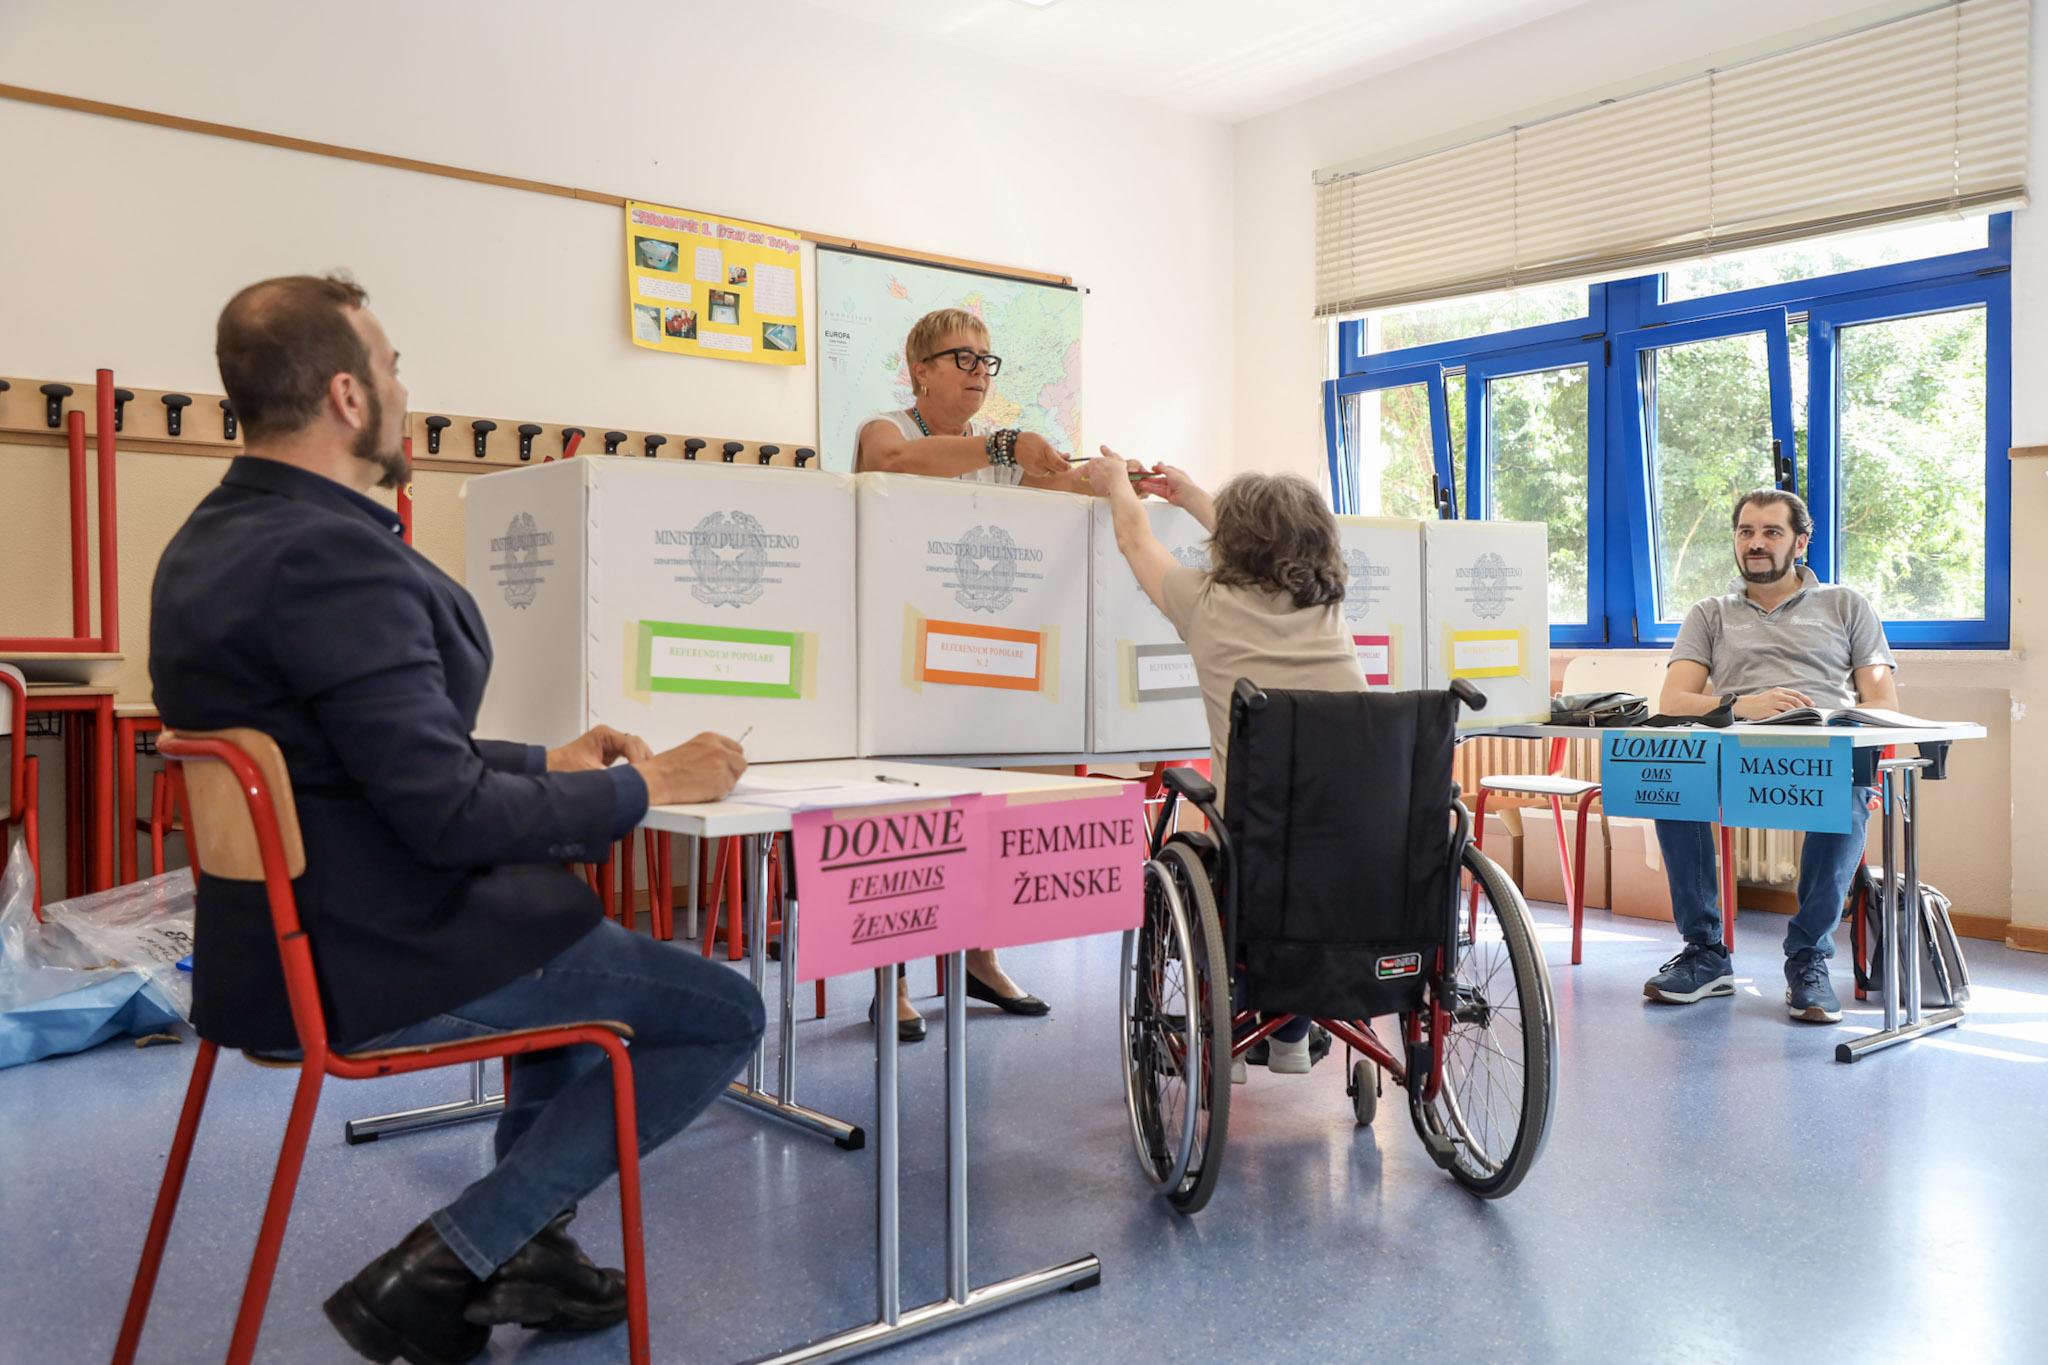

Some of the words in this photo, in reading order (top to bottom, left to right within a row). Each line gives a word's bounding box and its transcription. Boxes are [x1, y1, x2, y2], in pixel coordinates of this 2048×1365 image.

[824, 329, 851, 340] EUROPA
[655, 529, 718, 549] MINISTERO
[927, 540, 977, 557] MINISTERO
[669, 646, 729, 659] REFERENDUM
[731, 651, 774, 663] POPOLARE
[940, 641, 988, 656] REFERENDUM
[989, 647, 1024, 658] POPOLARE
[1610, 737, 1707, 760] UOMINI
[1641, 767, 1672, 780] OMS
[1739, 756, 1833, 777] MASCHI
[1635, 787, 1681, 803] MOŠKI
[1748, 784, 1824, 807] MOŠKI
[819, 809, 965, 862] DONNE
[1000, 818, 1135, 859] FEMMINE
[848, 864, 945, 899] FEMINIS
[1013, 866, 1122, 906] ŽENSKE
[852, 904, 940, 941] ŽENSKE
